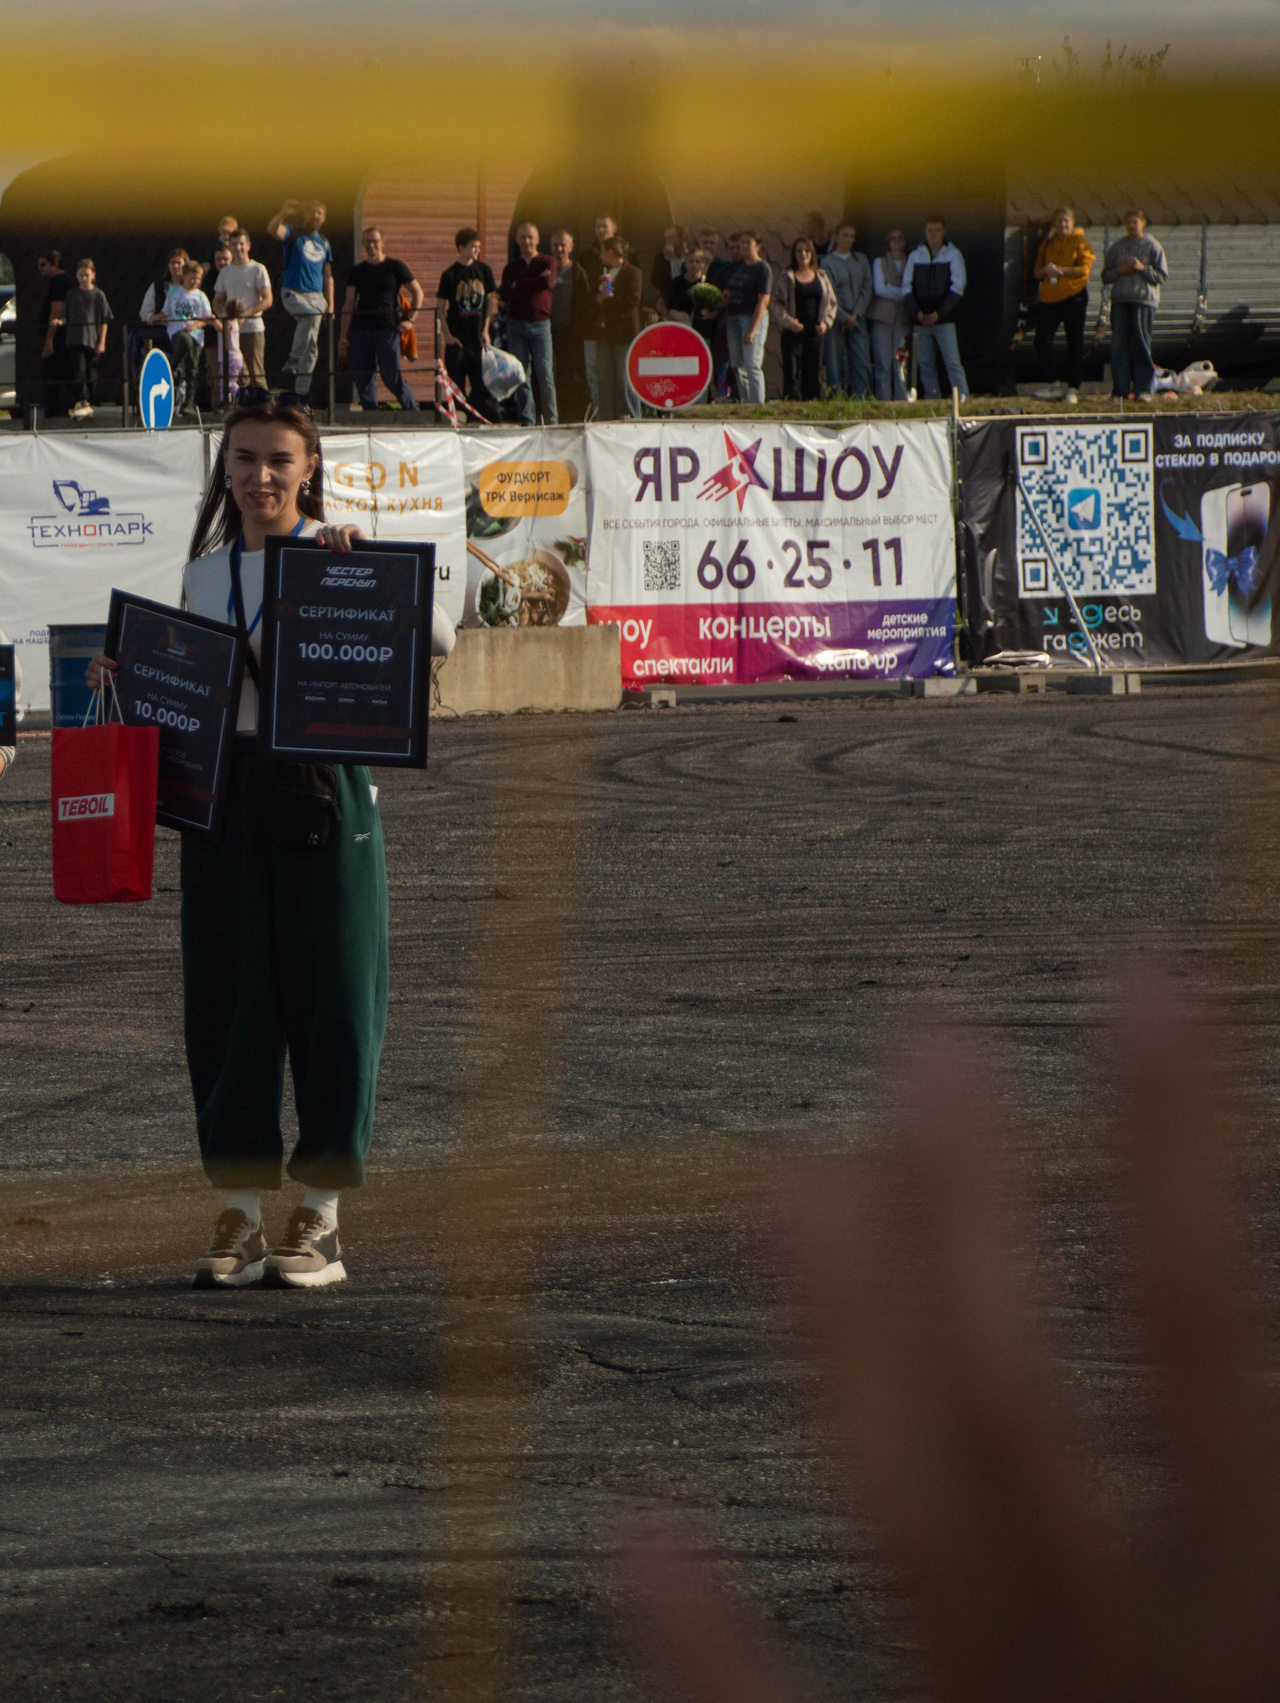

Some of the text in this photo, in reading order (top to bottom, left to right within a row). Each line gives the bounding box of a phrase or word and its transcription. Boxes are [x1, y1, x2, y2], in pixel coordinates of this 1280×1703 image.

[1174, 432, 1265, 449] ЗА ПОДПИСКУ
[1155, 453, 1205, 468] СТЕКЛО
[1209, 452, 1220, 466] В
[334, 461, 419, 489] GON
[496, 471, 551, 484] ФУДКОРТ
[633, 444, 904, 502] ЯР ШОУ
[485, 490, 565, 503] ТРК Вернисаж
[26, 521, 154, 538] ТЕХНОПАРК
[603, 519, 619, 529] ВСЕ
[621, 518, 660, 529] СОБЫТИЯ
[703, 516, 769, 528] ОФИЦИАЛЬНЫЕ
[805, 514, 881, 528] МАКСИМАЛЬНЫЙ
[883, 514, 914, 526] ВЫБОР
[915, 513, 938, 525] МЕСТ
[326, 565, 374, 576] ЧЕСТЕР
[299, 605, 396, 622] СЕРТИФИКАТ
[882, 613, 928, 626] детские
[319, 631, 369, 642] НА СУММУ
[699, 615, 832, 645] концерты
[867, 626, 947, 642] мероприятия
[26, 637, 49, 645] НАШЕ
[298, 642, 394, 662] 100.000₽
[632, 656, 733, 676] спектакли
[133, 662, 212, 697] СЕРТИФИКАТ
[309, 681, 338, 689] ИМПОРТ
[147, 691, 188, 711] НА СУММУ
[134, 699, 201, 732] 10.000₽
[61, 796, 108, 817] TEBOIL
